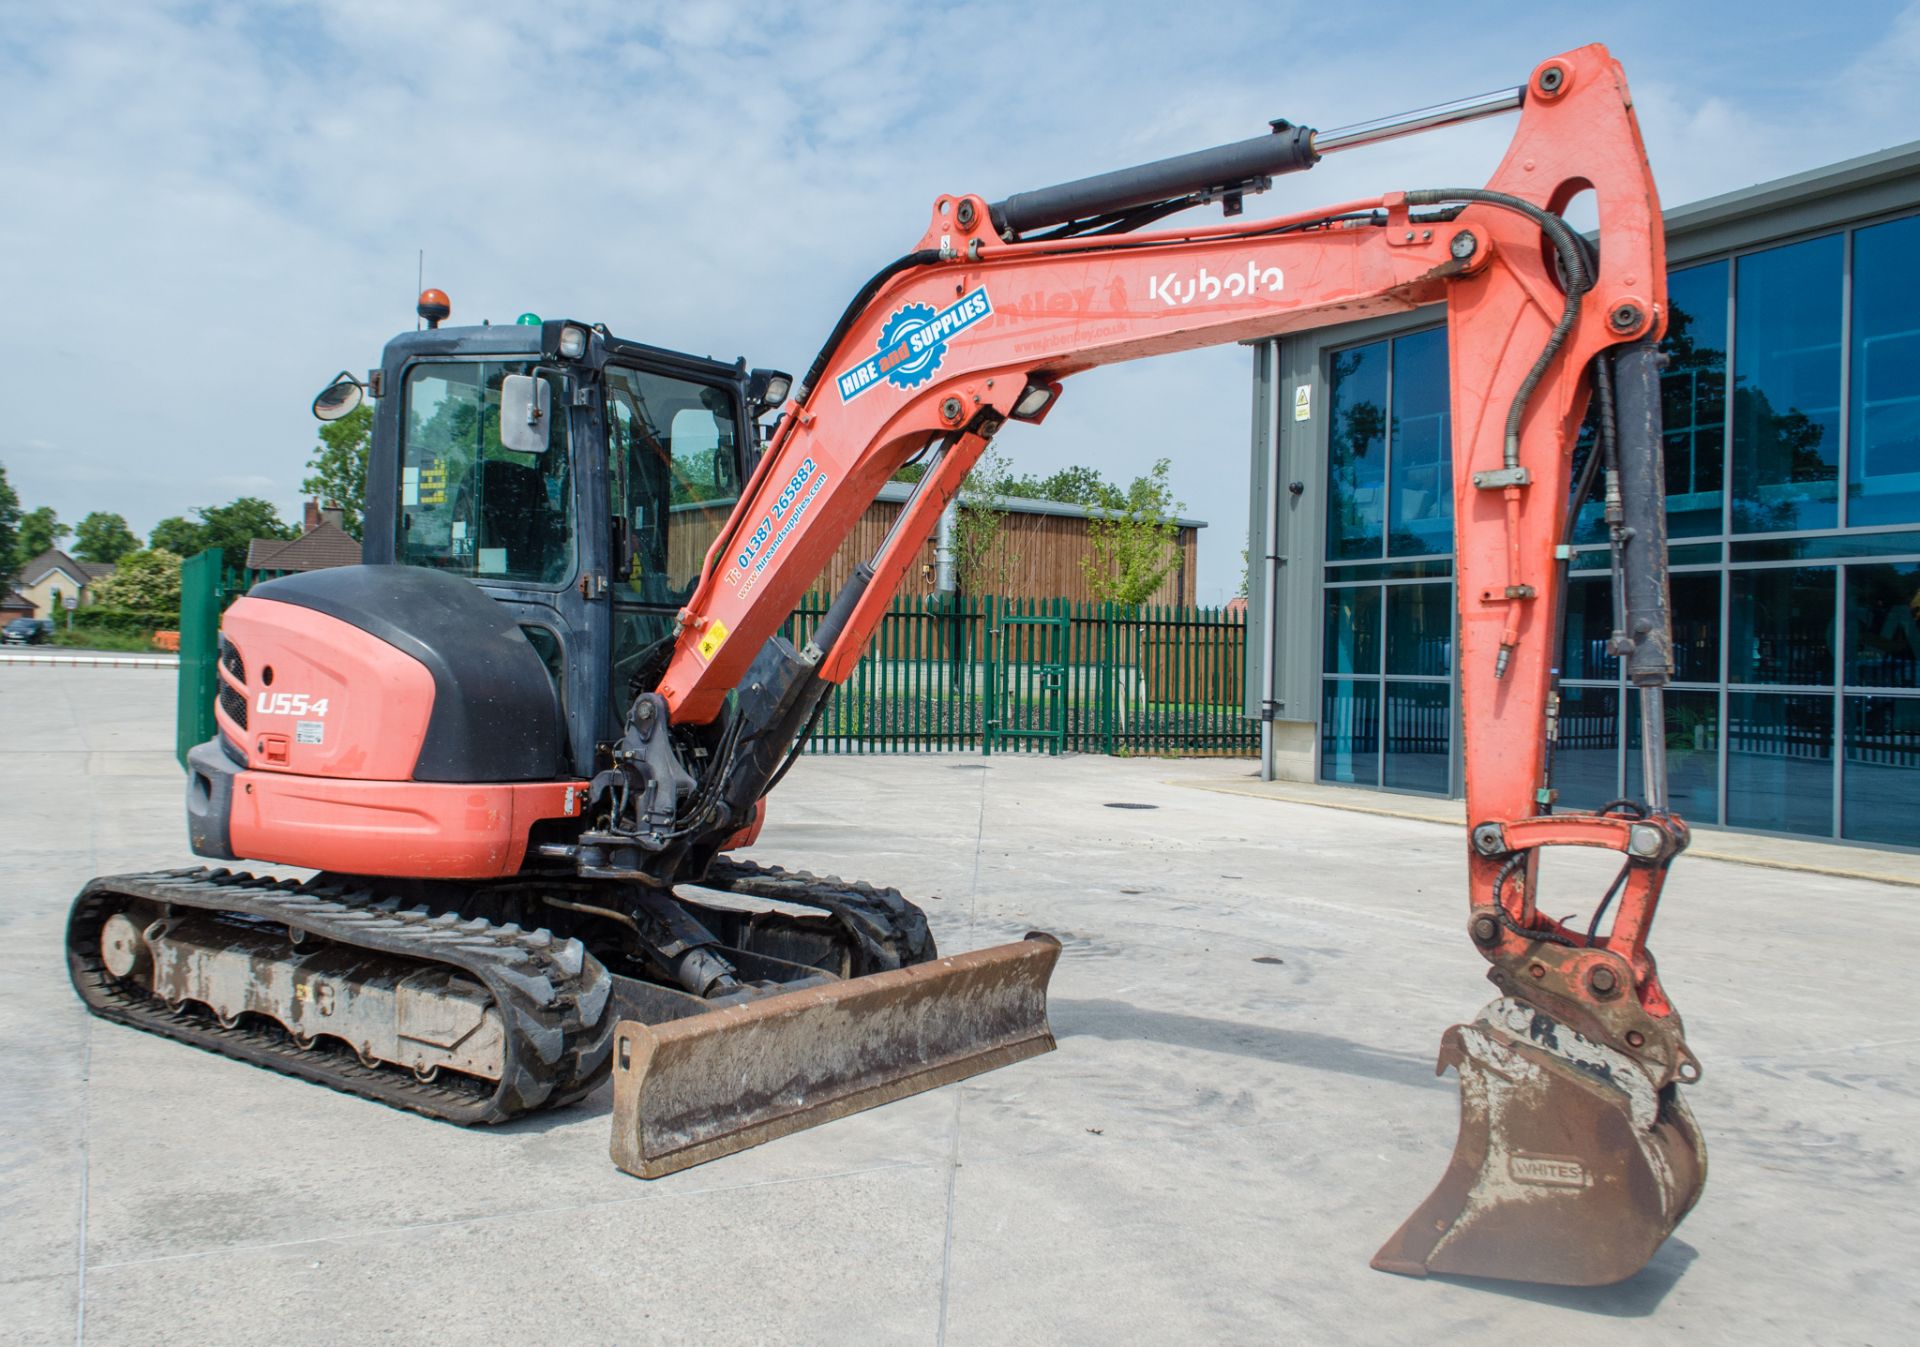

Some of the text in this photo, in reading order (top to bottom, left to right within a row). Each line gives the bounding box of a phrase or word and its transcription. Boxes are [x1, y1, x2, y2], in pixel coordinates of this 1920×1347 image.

[1150, 261, 1284, 305] Kubota
[841, 293, 987, 396] HIRE and SUPPLIES
[726, 458, 817, 585] T: 01387 265882
[738, 473, 827, 599] www.hireandsupplies.com
[256, 692, 329, 717] U55-4
[1514, 1161, 1580, 1178] WHITES
